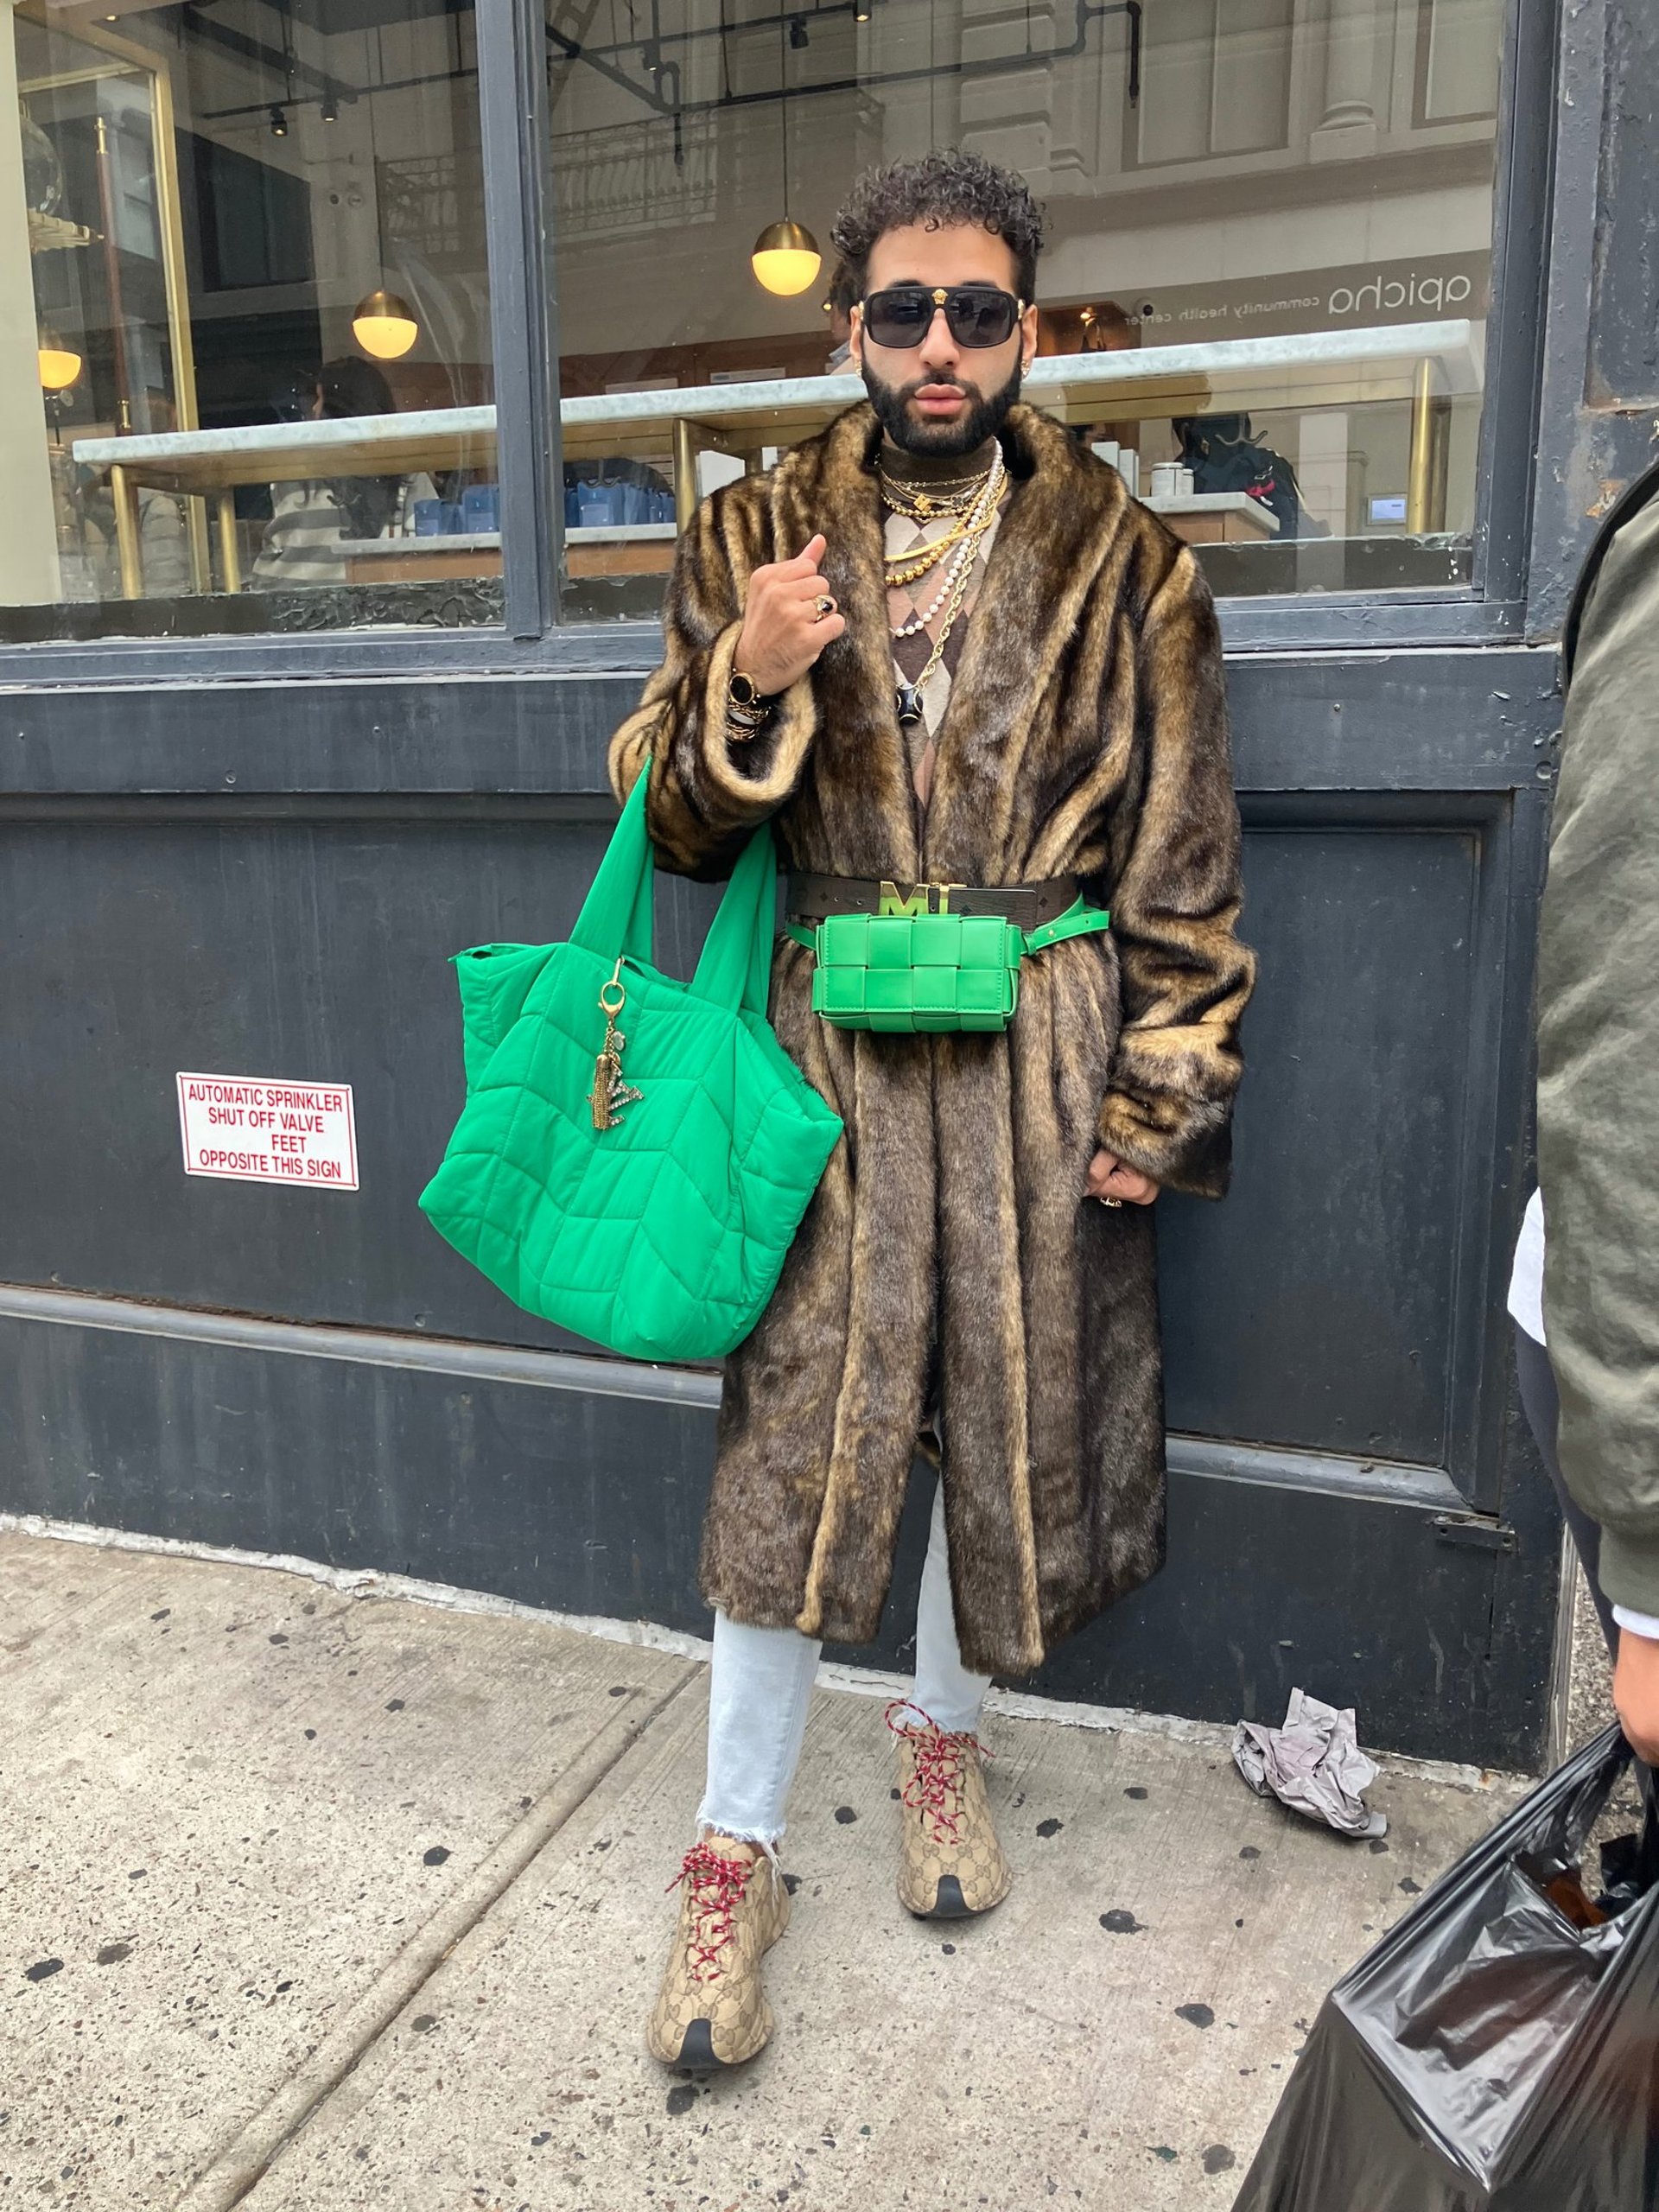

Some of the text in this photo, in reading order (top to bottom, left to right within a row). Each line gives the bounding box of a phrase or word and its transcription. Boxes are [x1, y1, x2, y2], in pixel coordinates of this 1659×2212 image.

[188, 1084, 343, 1112] AUTOMATIC SPRINKLER
[208, 1107, 324, 1133] SHUT OFF VALVE
[271, 1134, 307, 1154] FEET
[199, 1149, 341, 1179] OPPOSITE THIS SIGN
